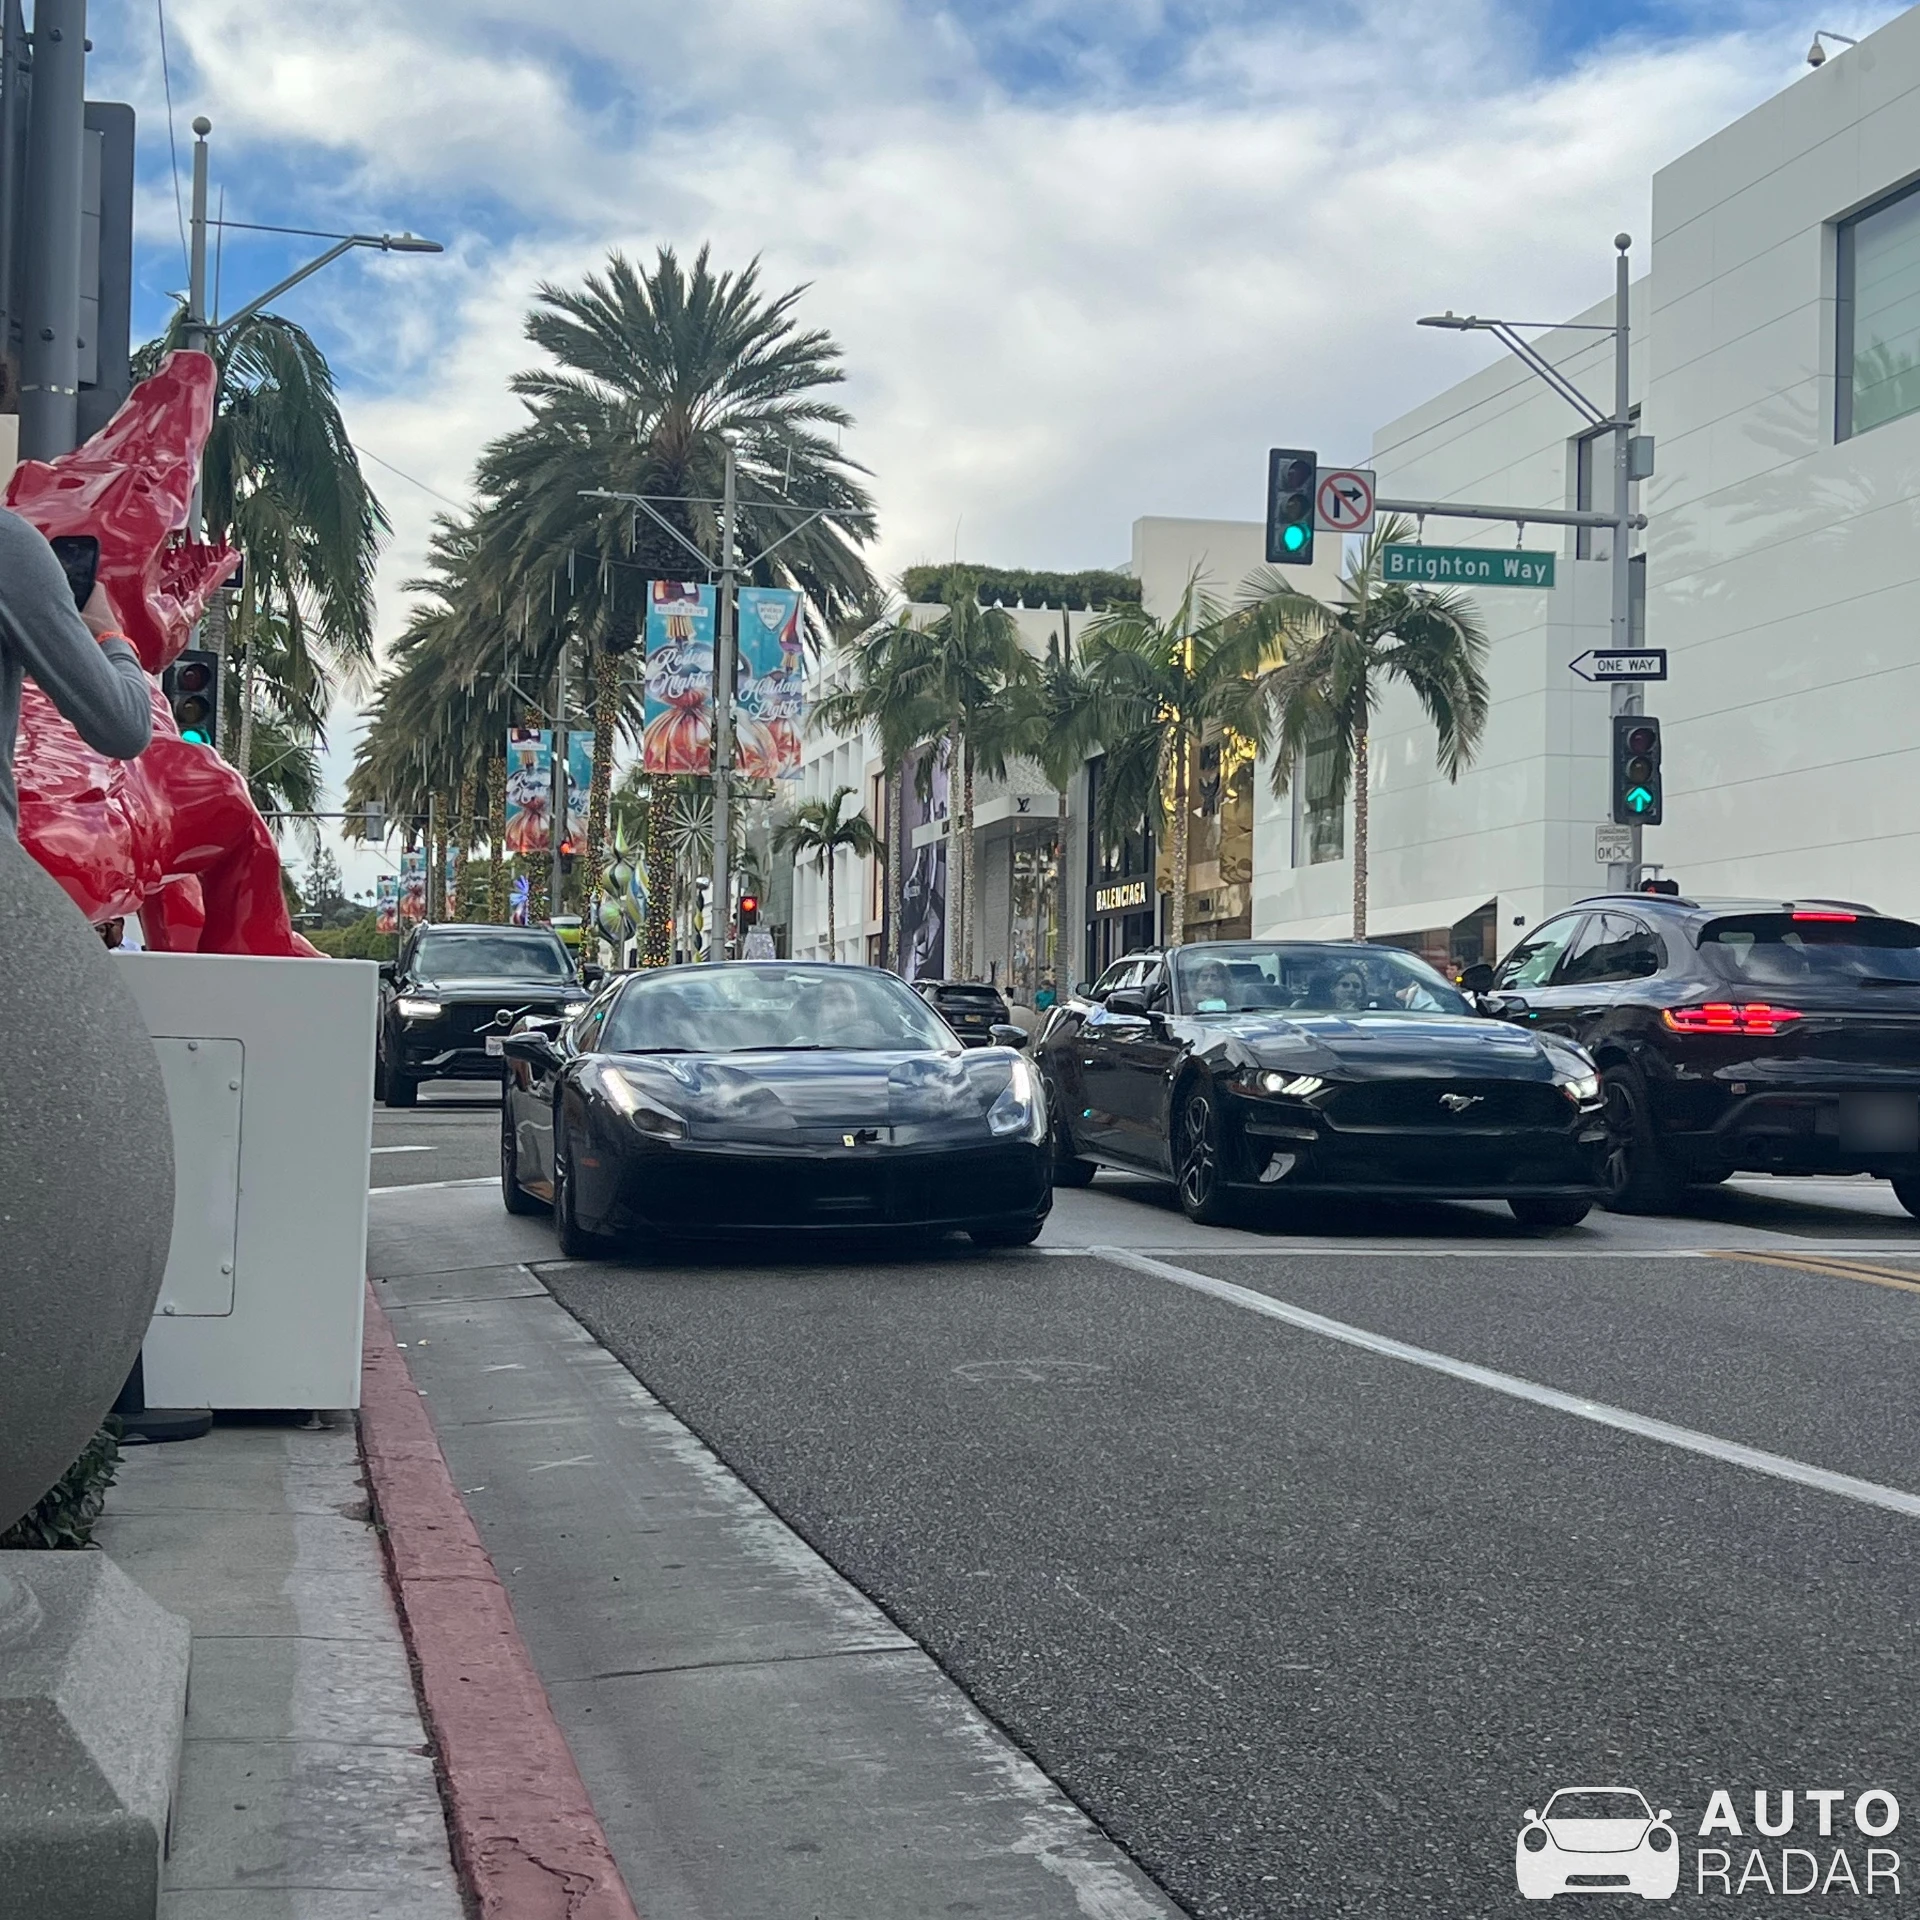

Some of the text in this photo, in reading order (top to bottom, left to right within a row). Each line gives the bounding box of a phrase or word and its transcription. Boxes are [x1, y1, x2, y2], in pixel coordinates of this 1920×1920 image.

[1390, 553, 1547, 583] Brighton Way
[655, 648, 706, 674] Rodeo
[1597, 659, 1655, 671] ONE WAY
[650, 671, 710, 698] Nights
[739, 678, 801, 701] Holiday
[749, 700, 800, 721] Lights
[1598, 847, 1612, 860] OK
[1096, 881, 1147, 912] BALENCIAGA
